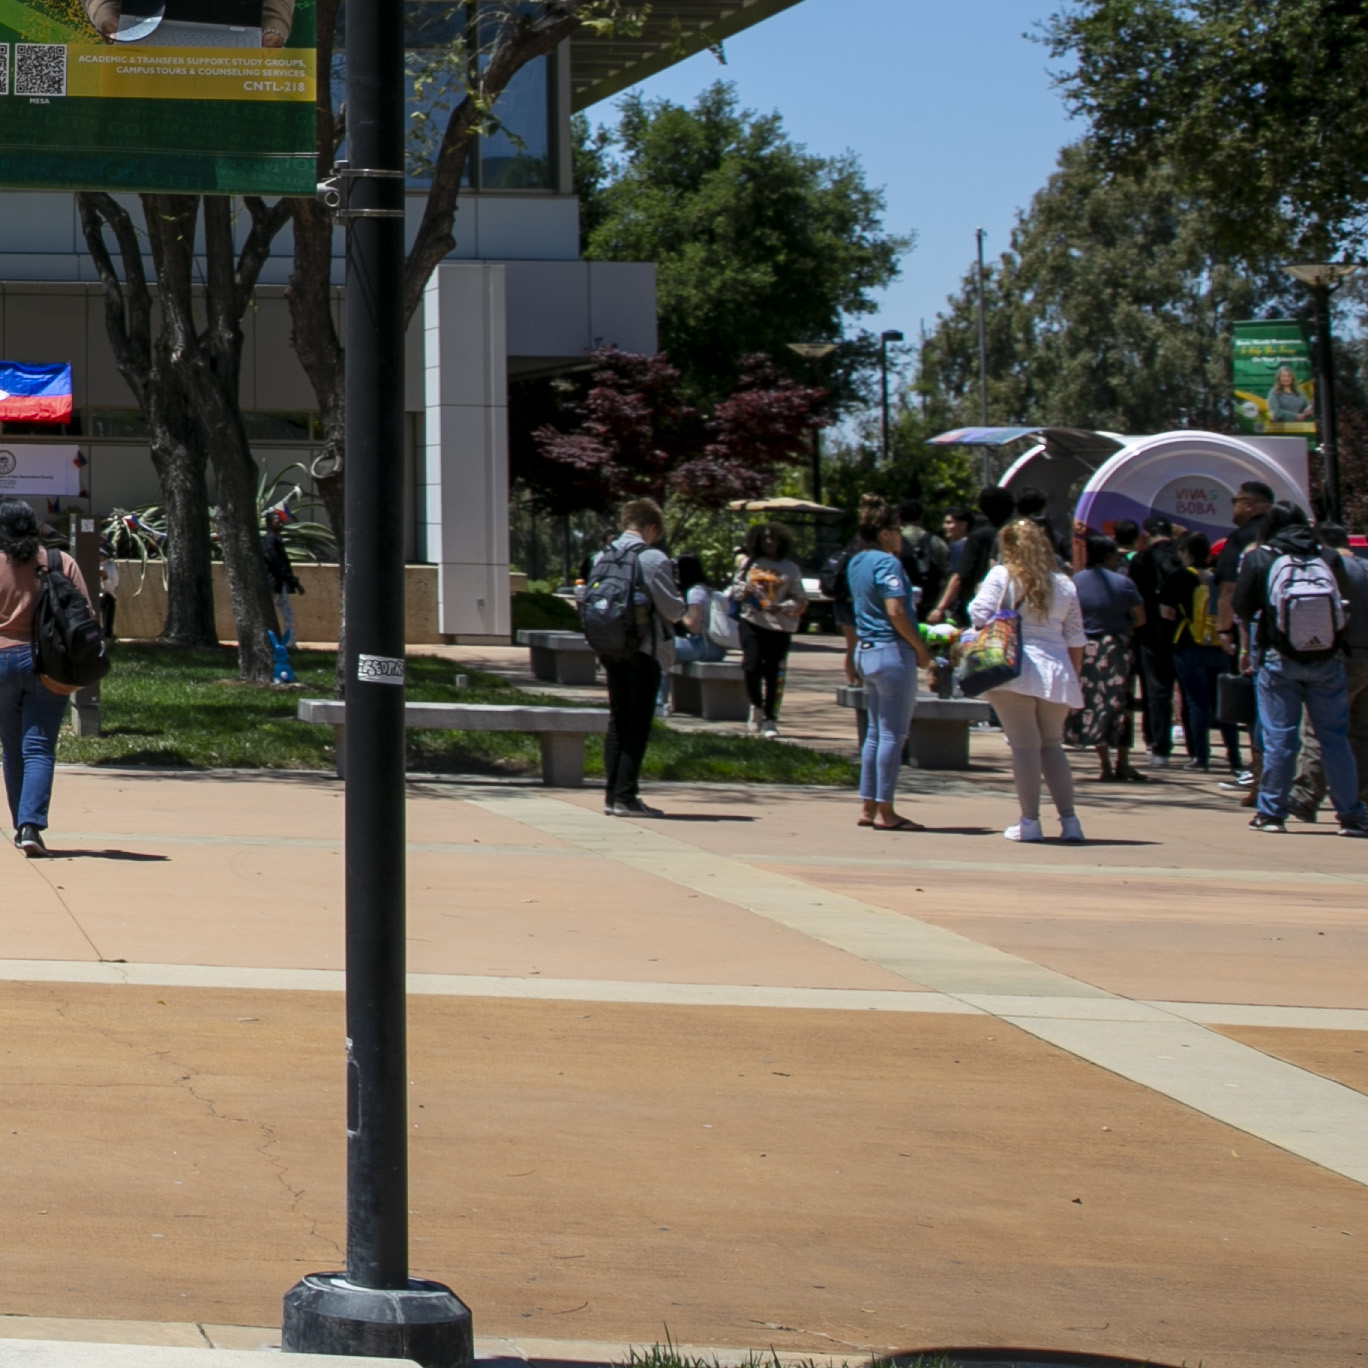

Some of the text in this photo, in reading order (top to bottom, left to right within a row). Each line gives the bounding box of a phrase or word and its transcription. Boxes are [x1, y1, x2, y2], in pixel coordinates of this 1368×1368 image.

[78, 55, 127, 64] ACADEMIC
[136, 56, 184, 66] TRANSFER
[186, 57, 231, 67] SUPPORT,
[231, 58, 263, 66] STUDY
[265, 59, 307, 68] GROUPS,
[116, 66, 305, 78] CAMPUS TOURS & COUNSELING SERVICES
[243, 80, 305, 92] CNTL-218
[1175, 487, 1208, 501] VIVA
[1175, 501, 1217, 516] BOBA
